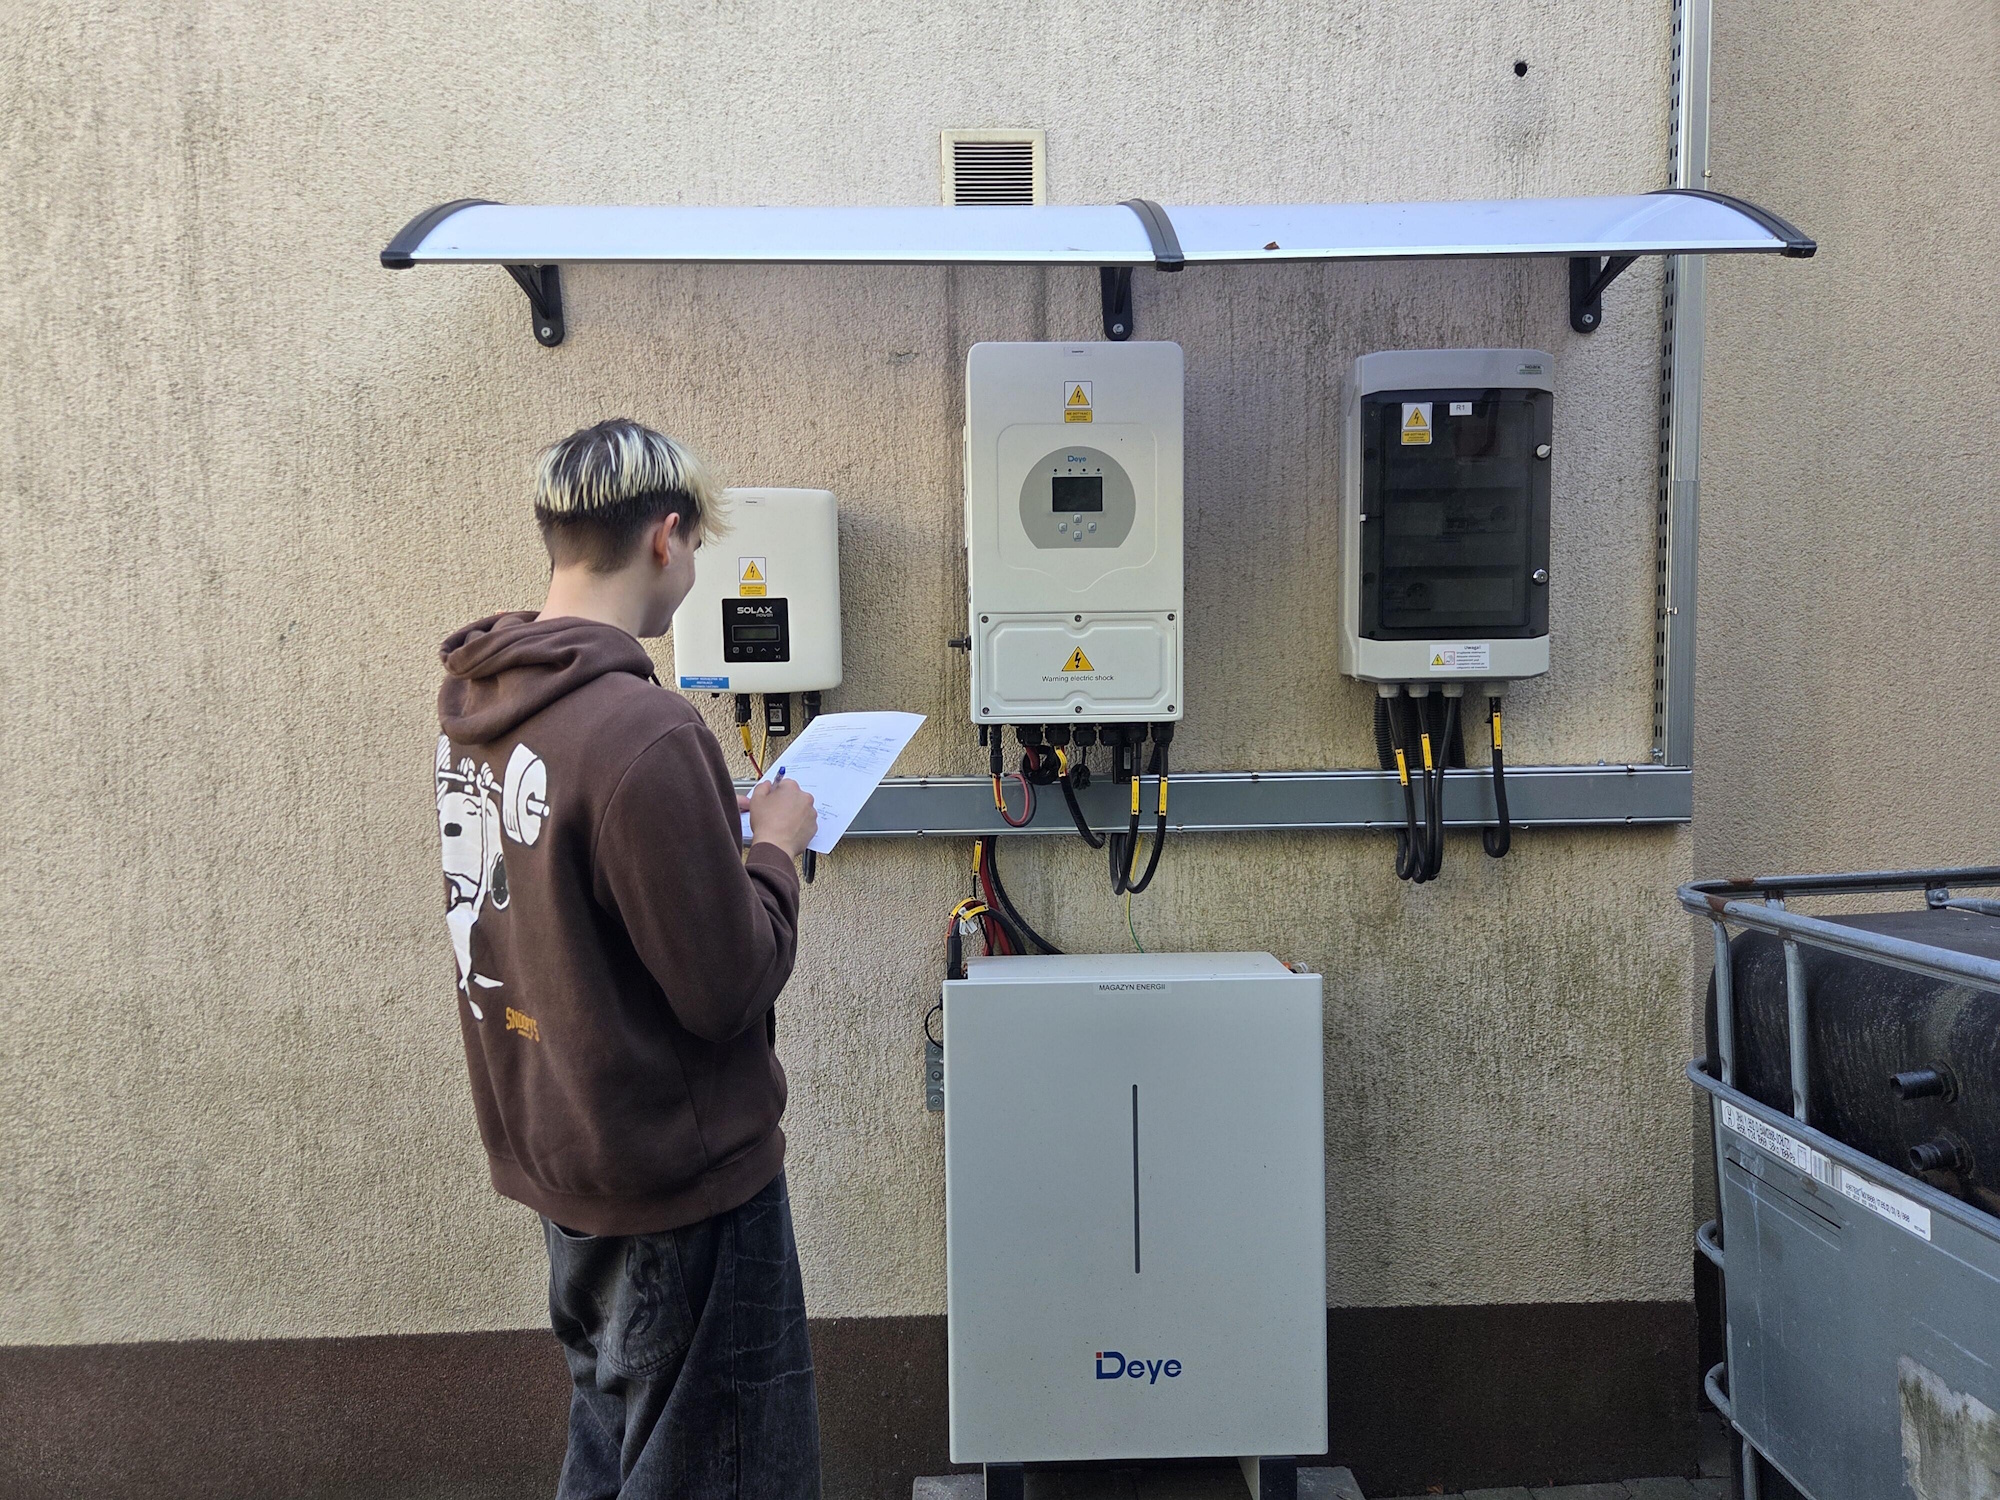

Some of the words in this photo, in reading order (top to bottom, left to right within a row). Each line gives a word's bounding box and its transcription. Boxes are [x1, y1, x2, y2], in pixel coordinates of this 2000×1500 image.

[1067, 455, 1087, 463] Deye
[736, 606, 773, 614] SOLAX
[1041, 675, 1069, 683] Warning
[1070, 674, 1094, 682] electric
[1098, 983, 1135, 991] MAGAZYN
[1095, 1351, 1182, 1385] Deye
